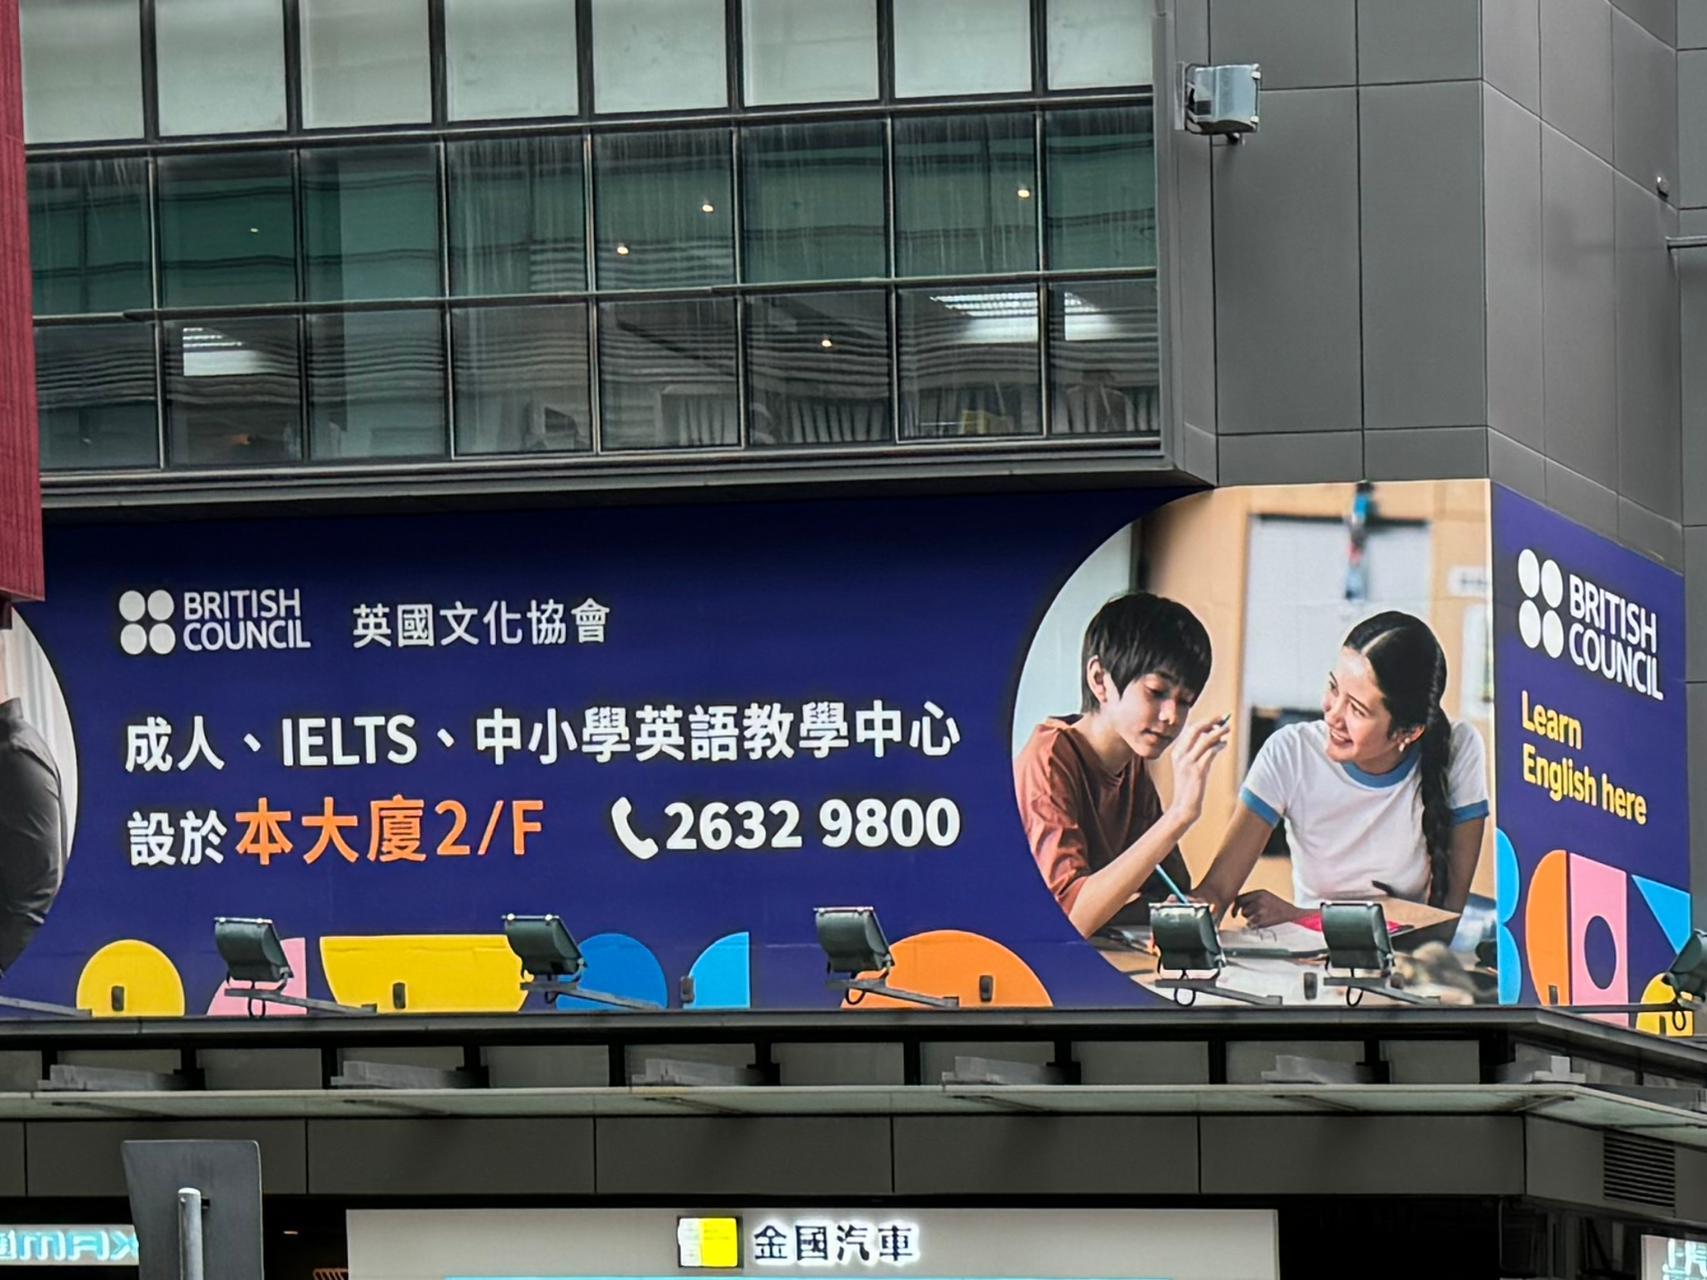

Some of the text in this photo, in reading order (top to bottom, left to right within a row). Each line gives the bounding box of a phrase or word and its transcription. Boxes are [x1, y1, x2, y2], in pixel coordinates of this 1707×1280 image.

[183, 589, 301, 620] BRITISH
[353, 597, 611, 650] 英國文化協會
[1569, 571, 1659, 655] BRITISH
[183, 618, 311, 652] COUNCIL
[1569, 622, 1664, 701] COUNCIL
[1521, 690, 1582, 750] Learn
[1523, 752, 1648, 826] English here
[664, 799, 801, 852] 2632
[820, 796, 961, 850] 9800
[752, 1222, 917, 1264] 金國汽車
